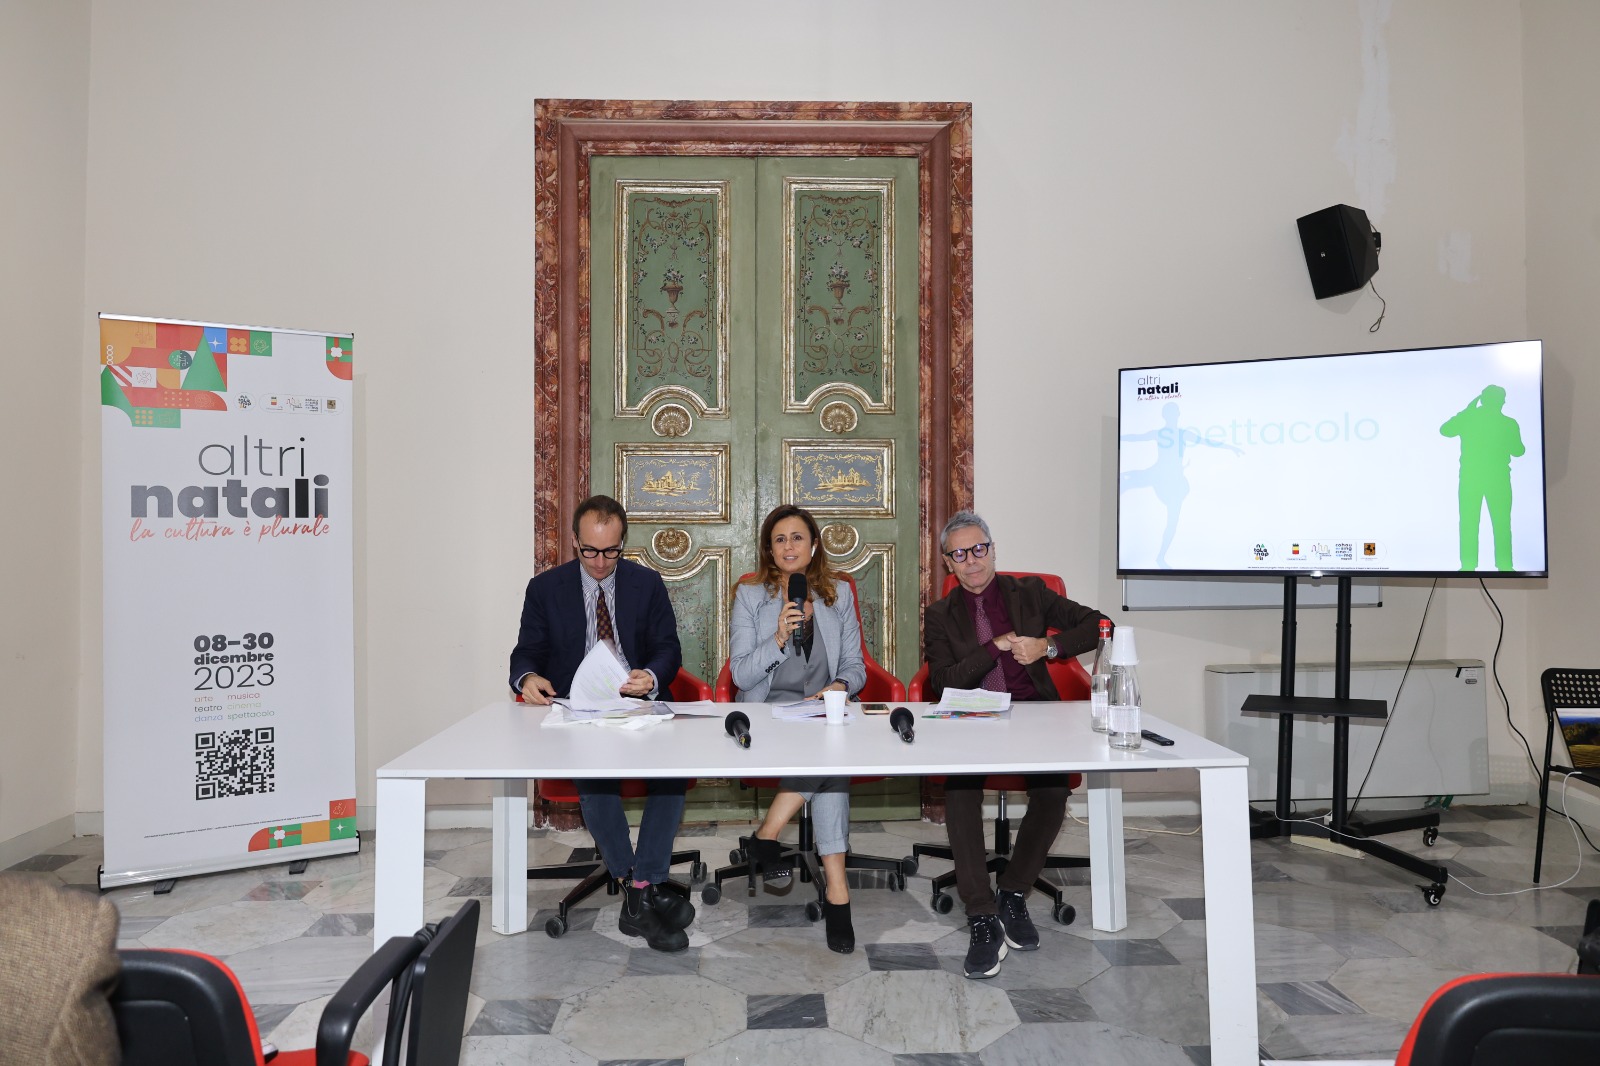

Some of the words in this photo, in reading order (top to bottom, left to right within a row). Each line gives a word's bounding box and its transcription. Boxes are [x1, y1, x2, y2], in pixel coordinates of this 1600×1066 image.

[1138, 374, 1160, 385] altri
[1138, 382, 1178, 395] natali
[1157, 411, 1380, 458] spettacolo
[198, 434, 306, 477] altri
[130, 473, 330, 519] natali
[129, 518, 155, 542] la
[164, 516, 235, 542] cultura
[243, 520, 252, 536] è
[257, 513, 331, 544] plurale
[193, 651, 274, 666] dicembre
[193, 662, 275, 691] 2023
[227, 692, 261, 700] musica
[194, 704, 223, 713] teatro
[194, 714, 224, 723] danza
[227, 710, 275, 721] spettacolo
